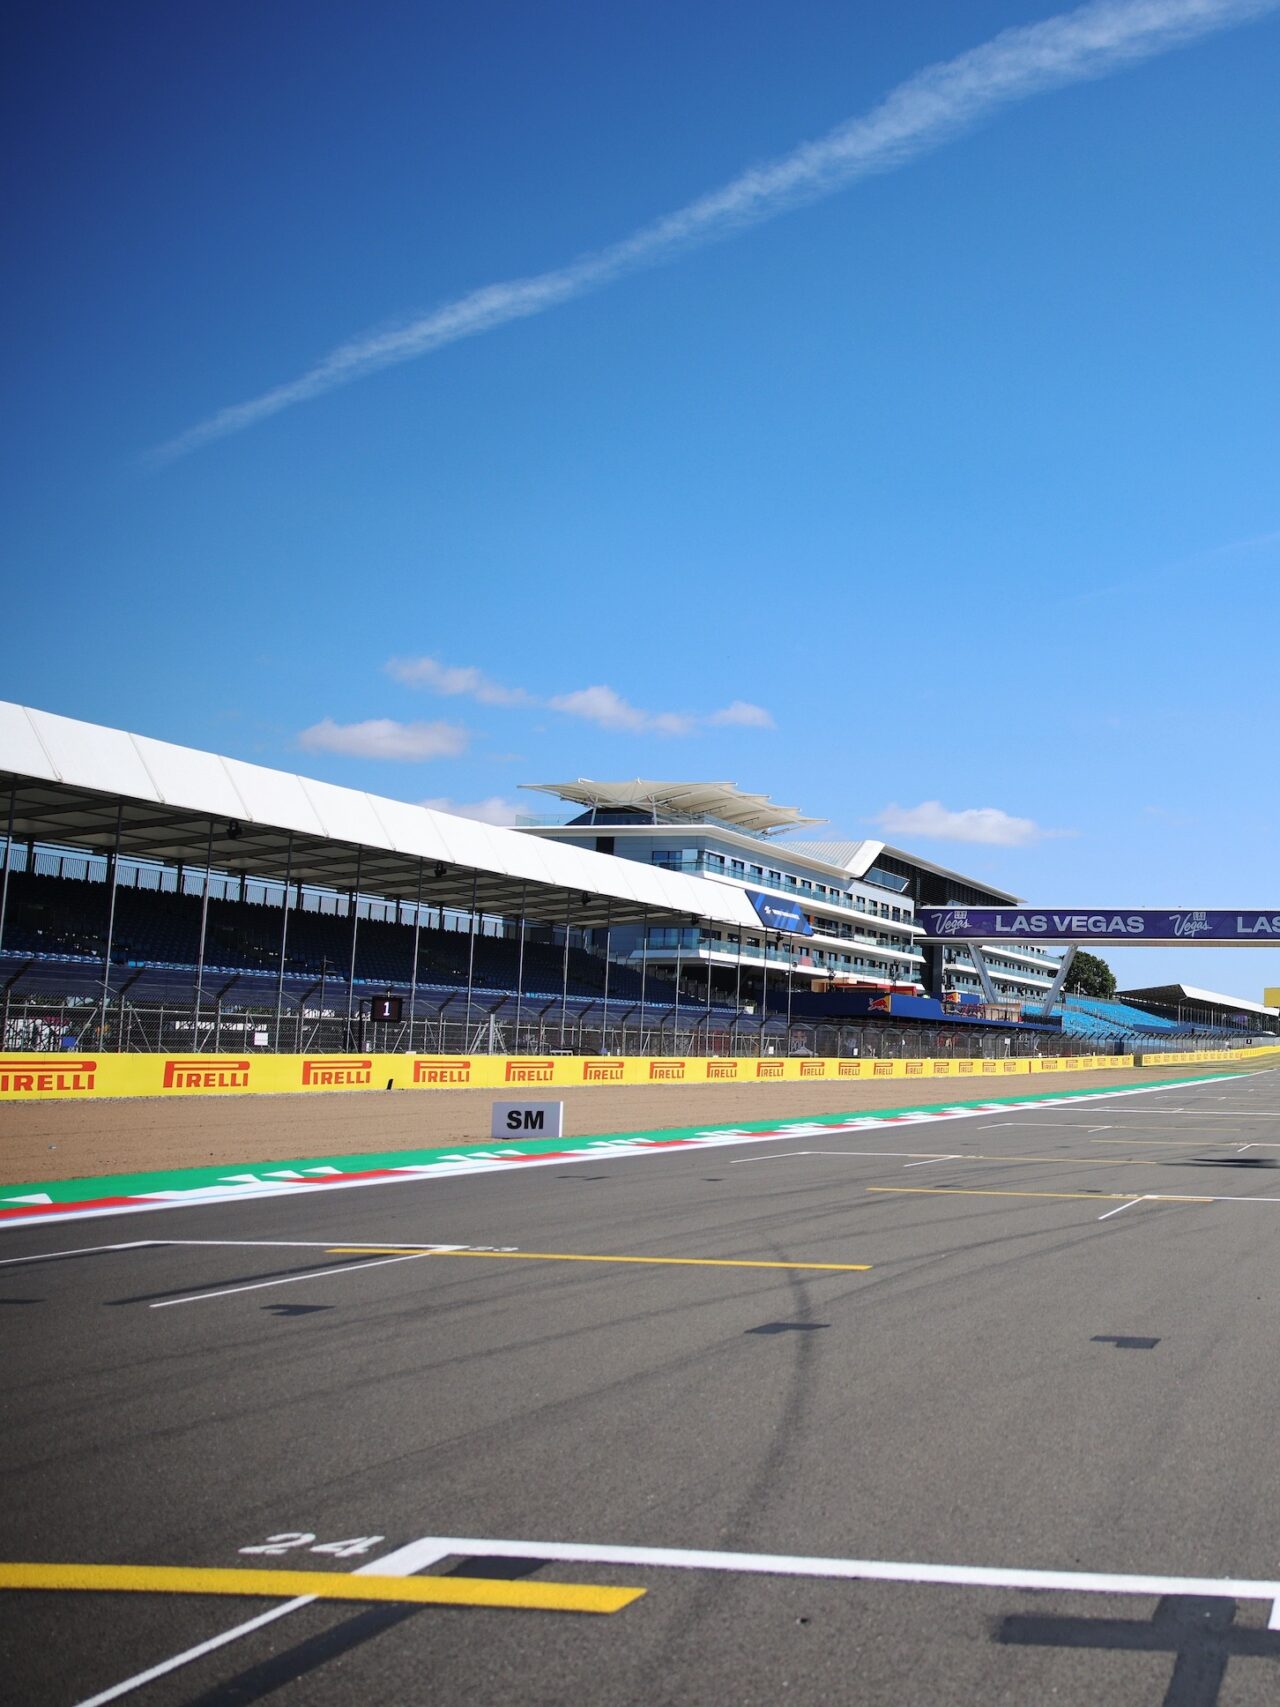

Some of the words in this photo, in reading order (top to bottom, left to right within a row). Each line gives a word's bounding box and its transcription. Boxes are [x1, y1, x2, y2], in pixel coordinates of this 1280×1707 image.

[931, 912, 973, 935] Vegas
[995, 915, 1048, 933] LAS
[1052, 915, 1145, 933] VEGAS
[1169, 912, 1213, 938] Vegas
[383, 1002, 390, 1017] 1
[163, 1061, 250, 1088] PIRELLI
[302, 1060, 372, 1085] PIRELLI
[413, 1060, 471, 1082] PIRELLI
[505, 1061, 554, 1081] PIRELLI
[583, 1061, 624, 1080] PIRELLI
[649, 1061, 686, 1079] PIRELLI
[706, 1061, 738, 1078] PIRELLI
[756, 1061, 784, 1077] PIRELLI
[800, 1061, 825, 1076] PIRELLI
[838, 1061, 861, 1076] PIRELLI
[873, 1061, 893, 1075] PIRELLI
[506, 1110, 544, 1130] SM
[238, 1532, 386, 1558] 24
